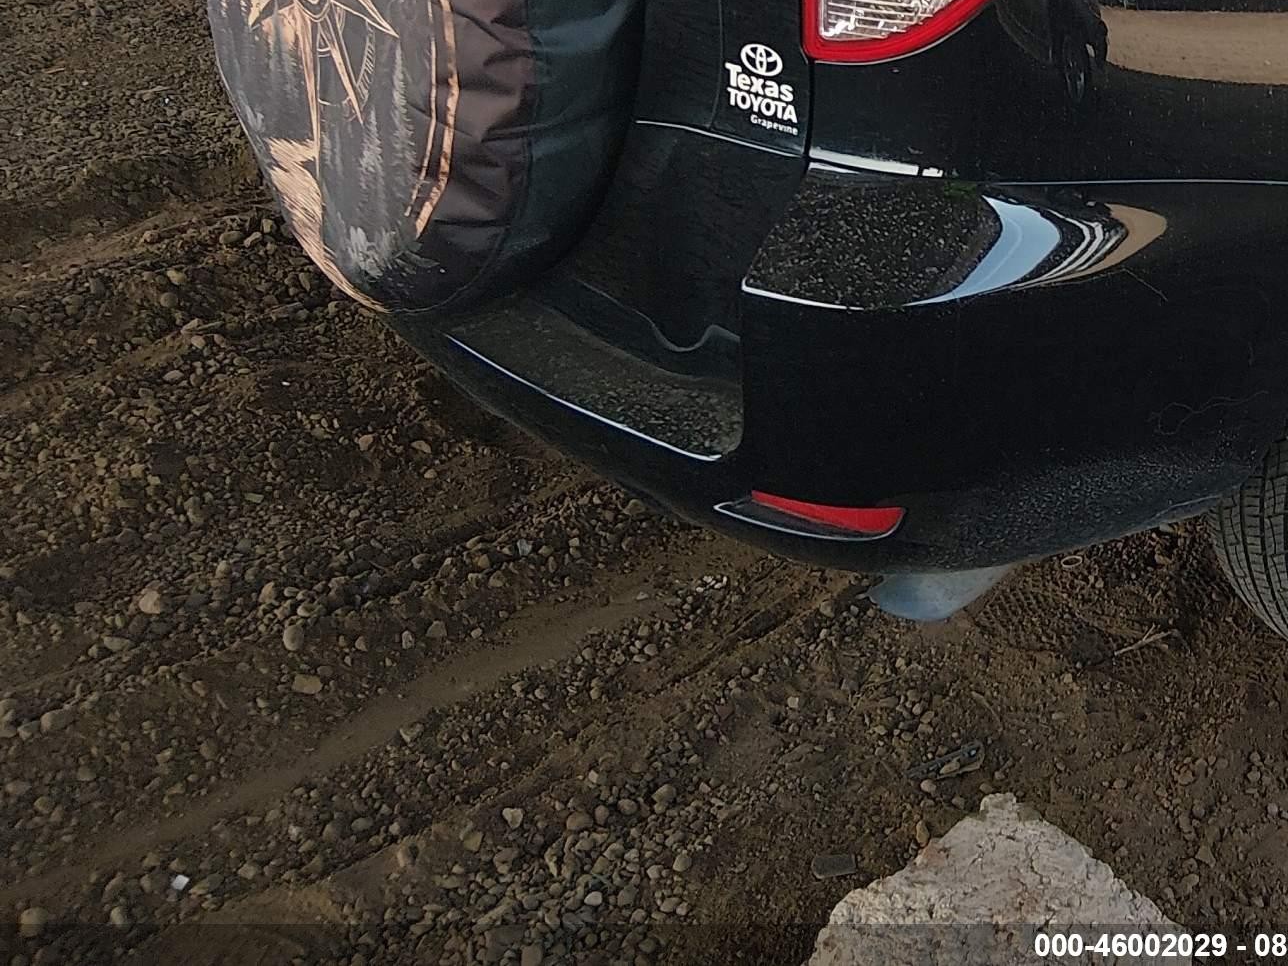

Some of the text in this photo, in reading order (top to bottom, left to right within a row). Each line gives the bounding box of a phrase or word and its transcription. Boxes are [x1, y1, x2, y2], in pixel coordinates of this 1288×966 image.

[724, 62, 794, 102] Texas
[726, 87, 798, 124] TOYOTA
[750, 114, 799, 136] Grapevine
